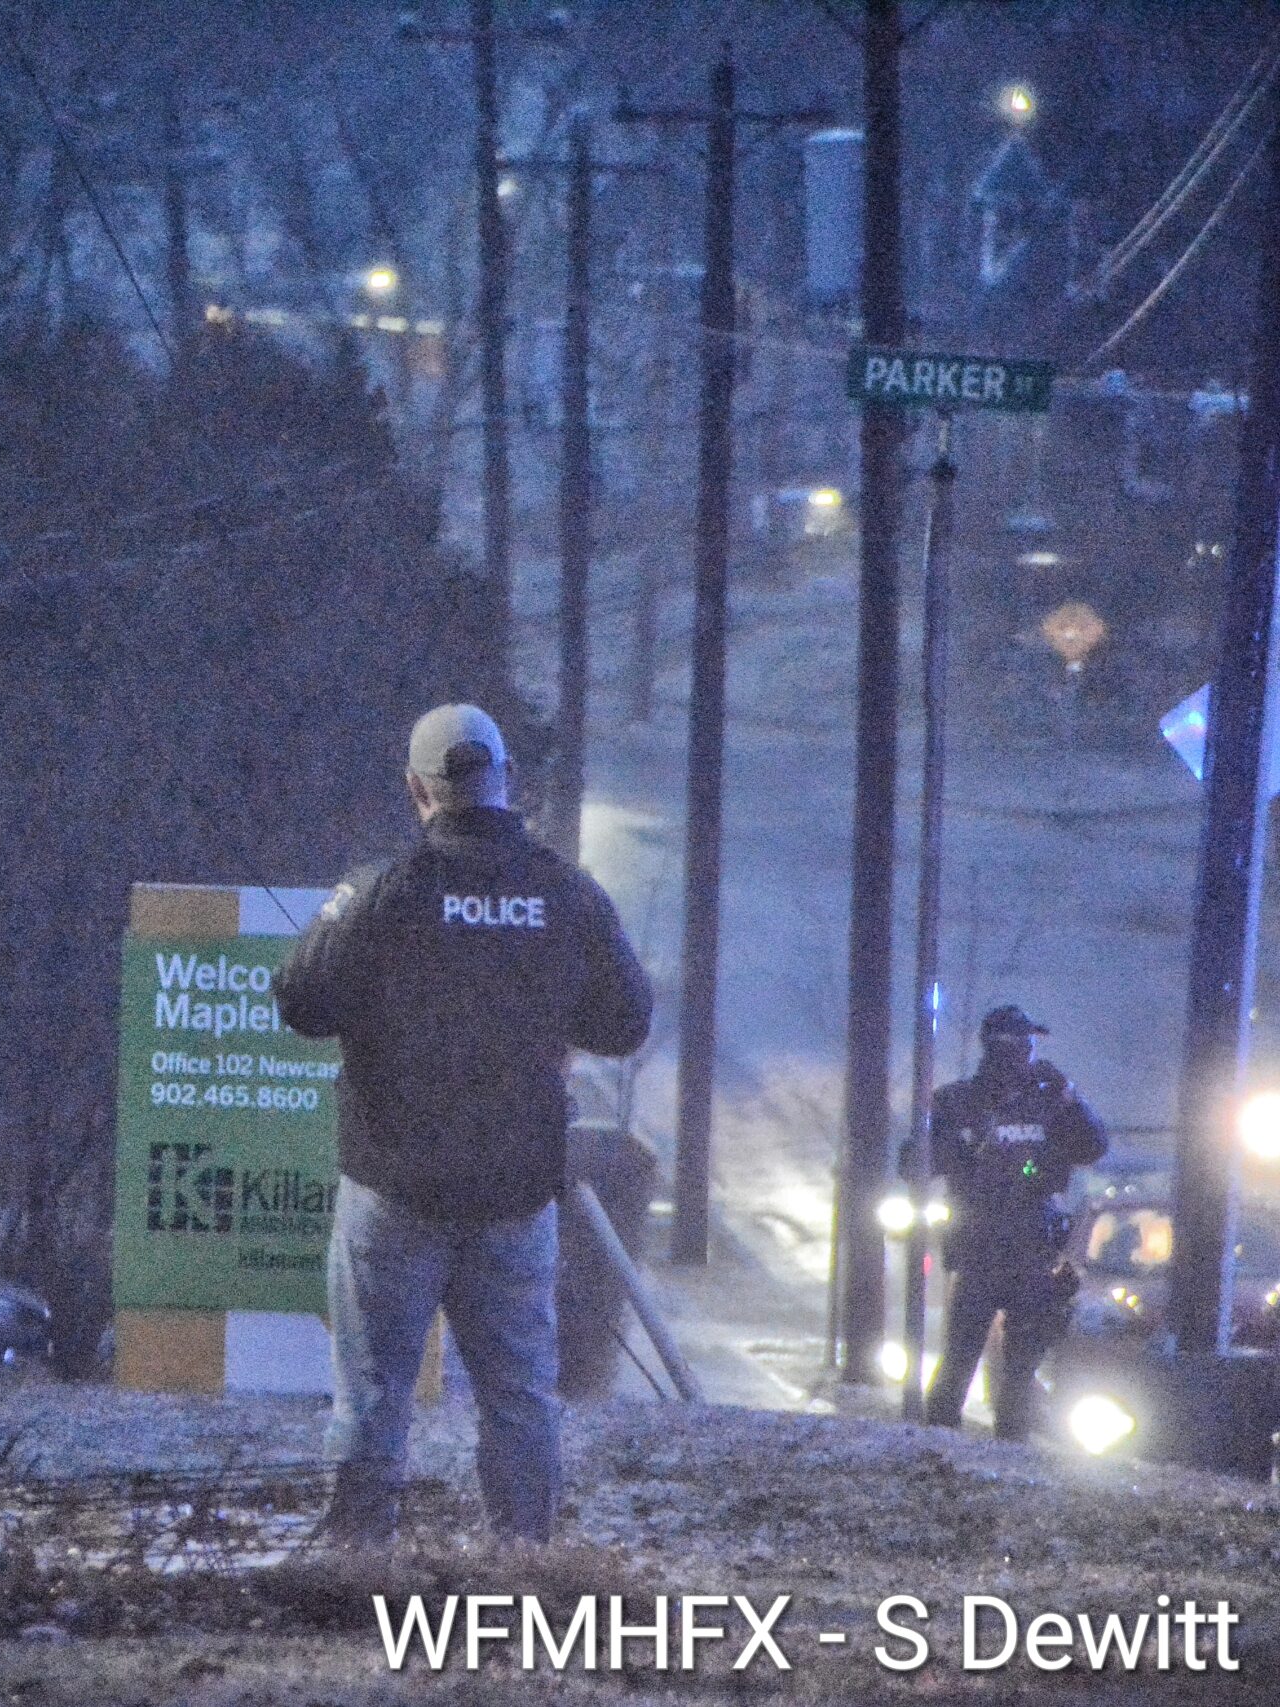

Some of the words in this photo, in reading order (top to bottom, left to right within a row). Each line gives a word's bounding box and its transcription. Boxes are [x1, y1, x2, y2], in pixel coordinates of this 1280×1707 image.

[864, 357, 1006, 400] PARKER
[442, 895, 546, 928] POLICE
[155, 953, 271, 993] Welco
[151, 1051, 212, 1075] Office
[216, 1054, 254, 1077] 102
[150, 1082, 319, 1111] 902.465.8600
